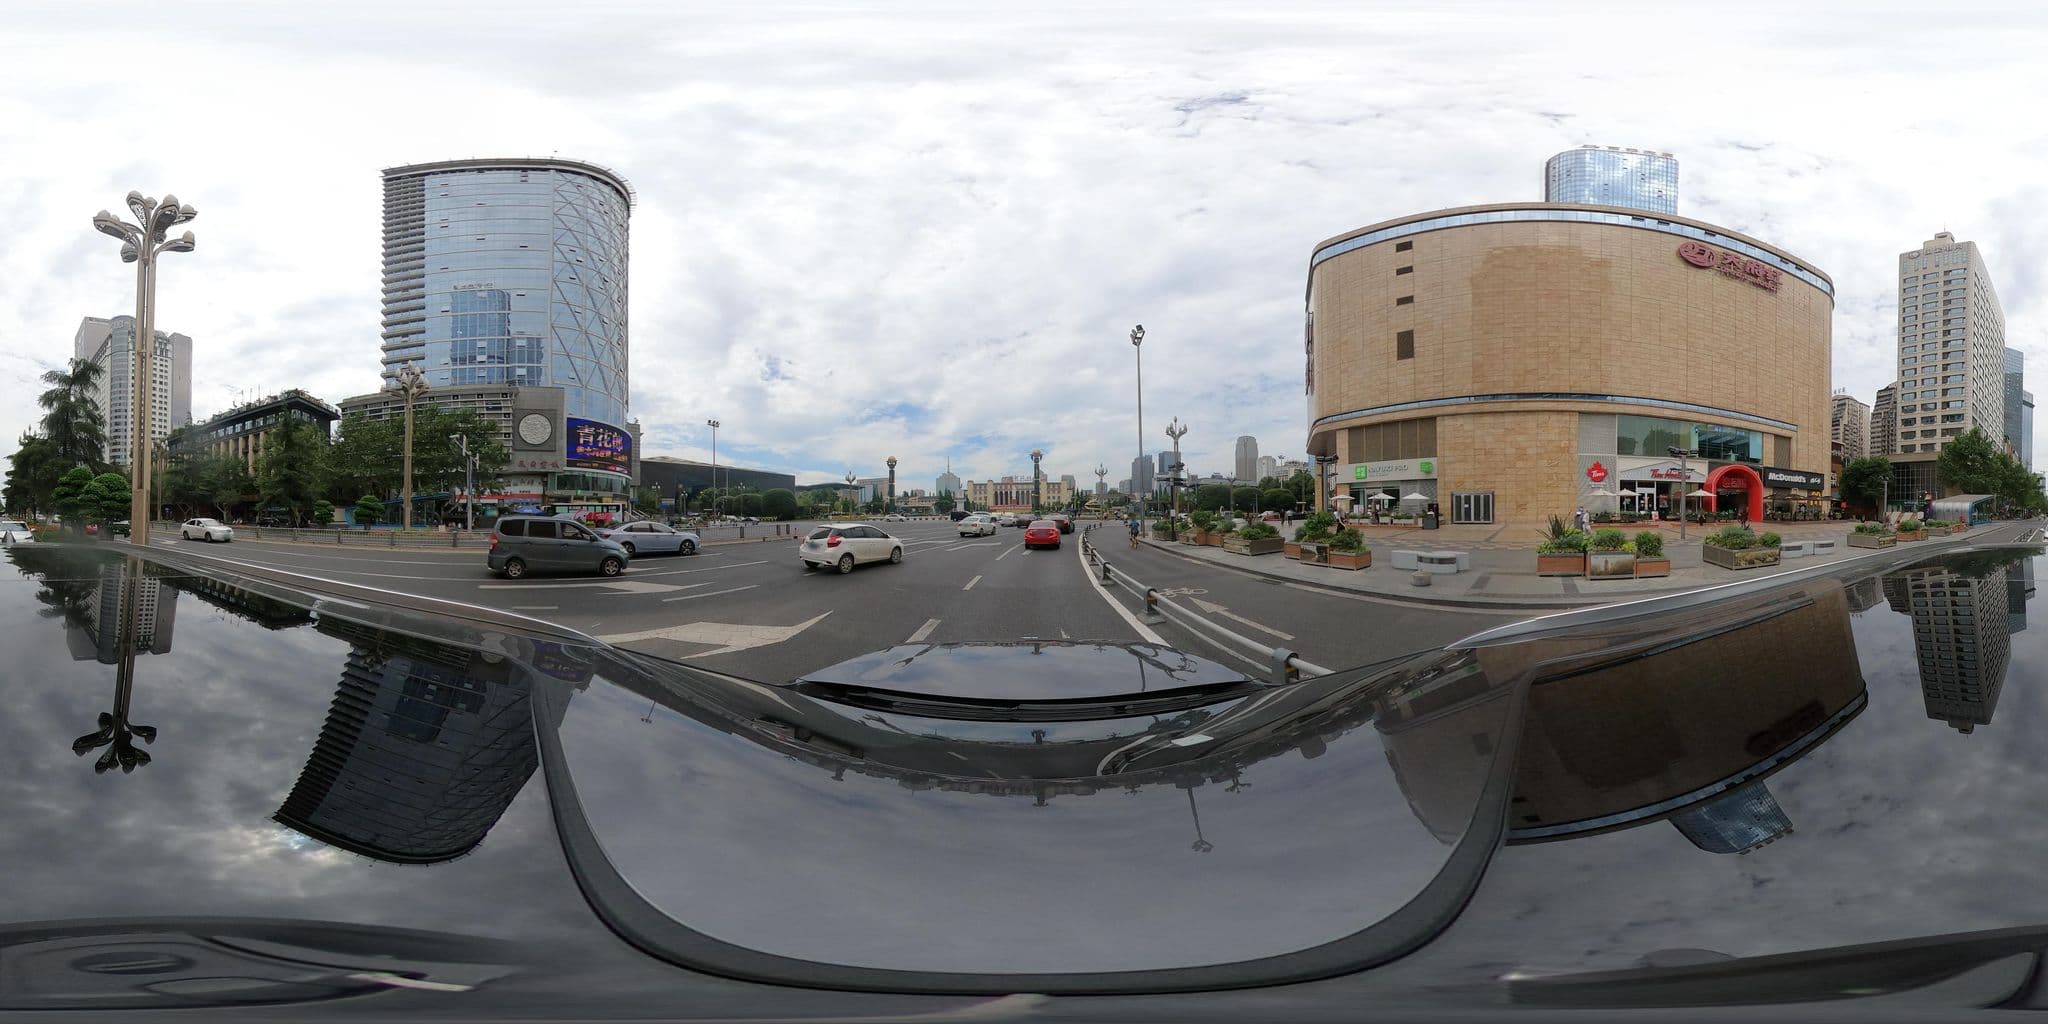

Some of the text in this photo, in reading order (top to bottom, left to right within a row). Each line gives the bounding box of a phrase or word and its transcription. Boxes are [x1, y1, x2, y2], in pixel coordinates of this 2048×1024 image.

[576, 425, 624, 452] 青花郎
[1768, 472, 1806, 483] McDonald's
